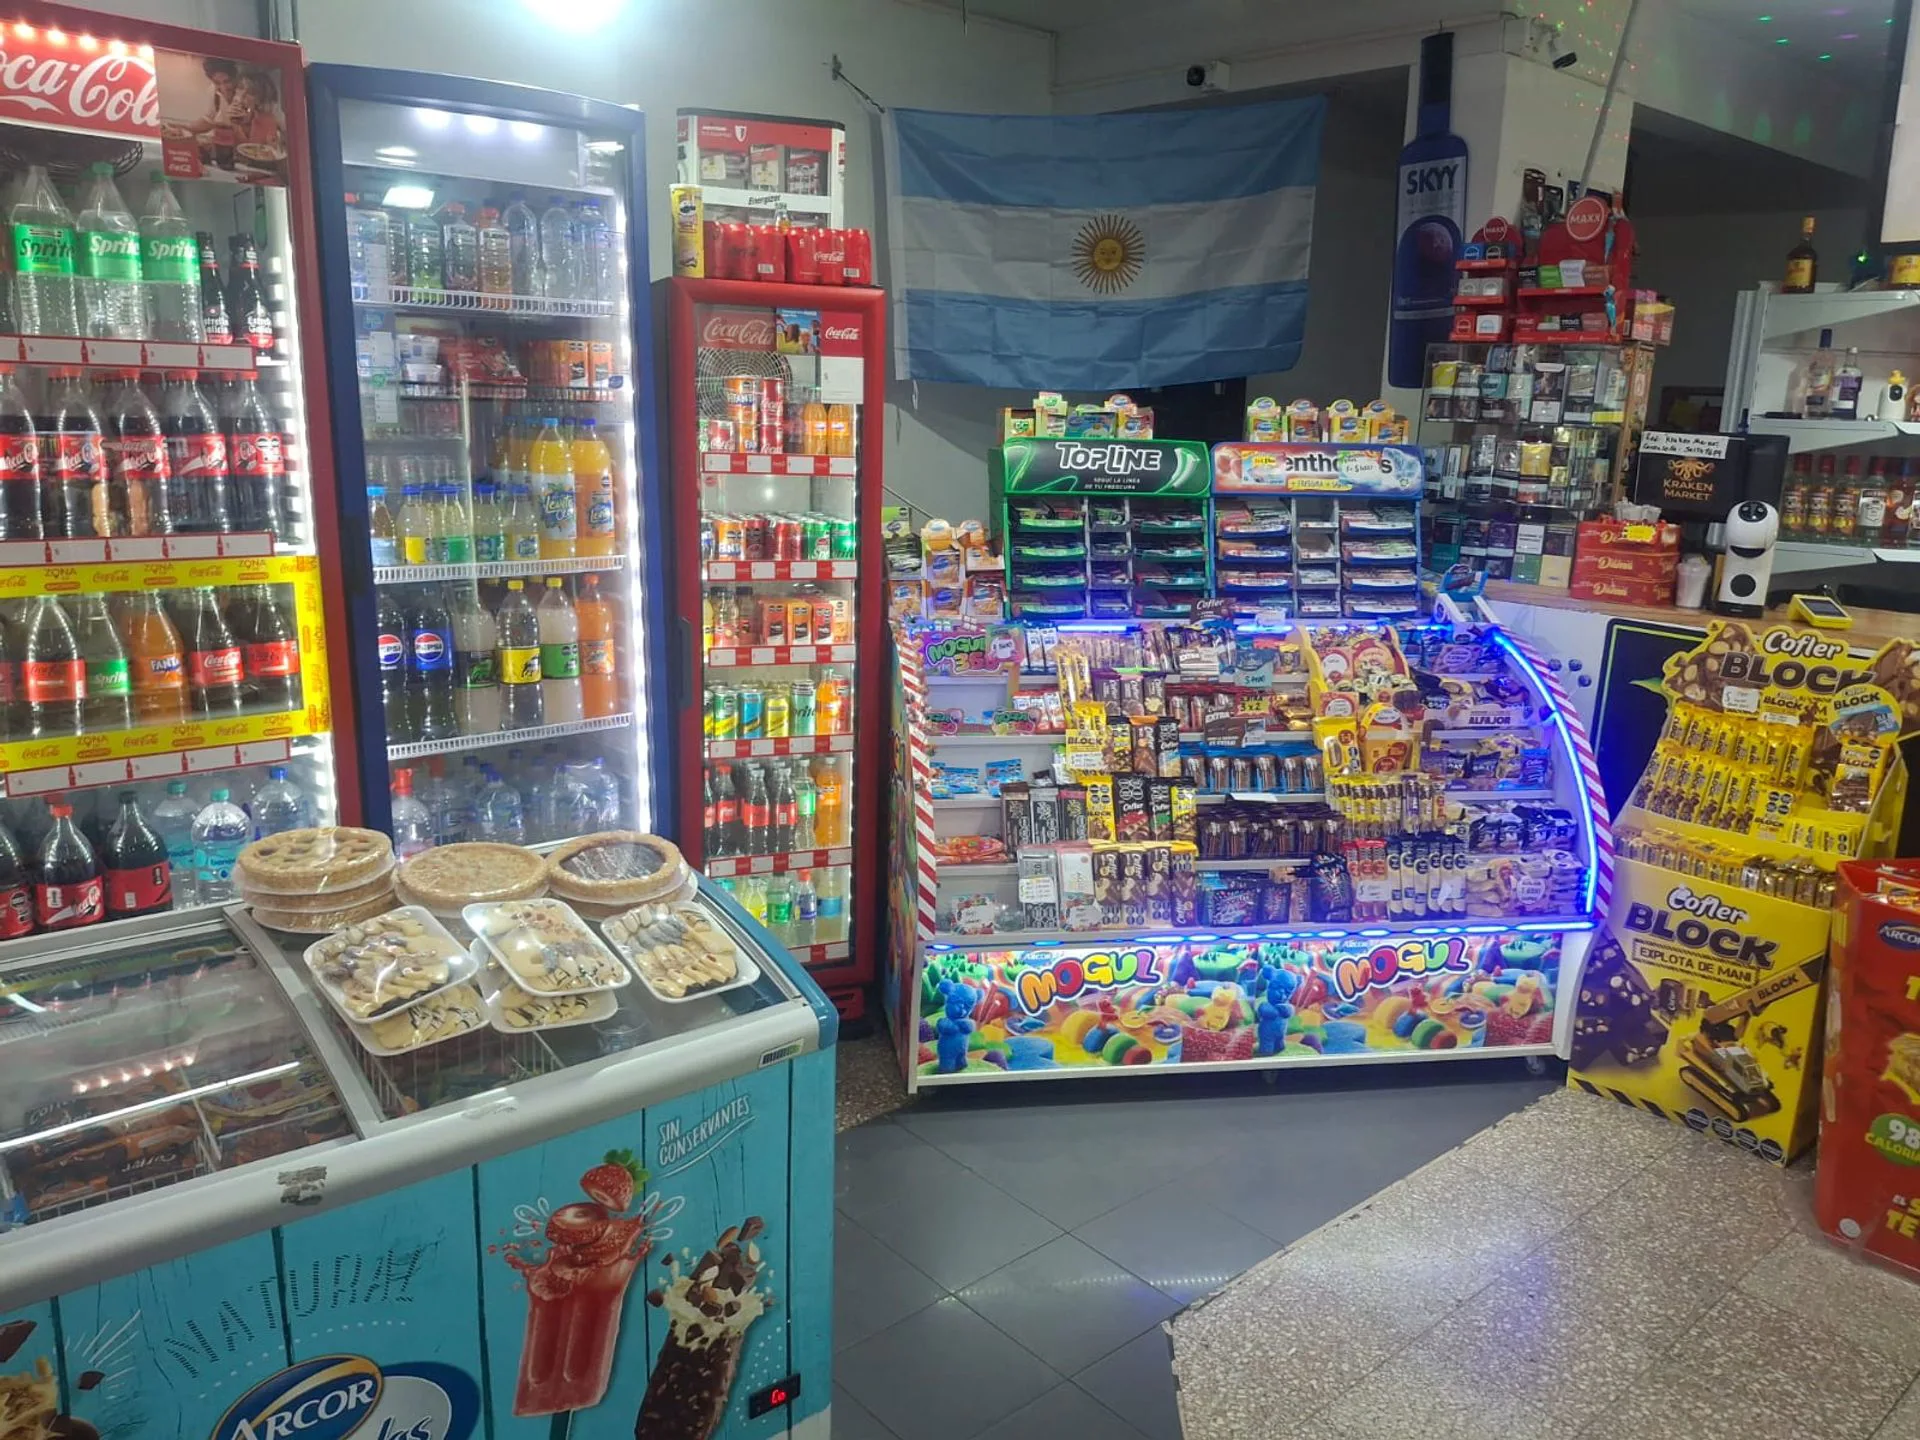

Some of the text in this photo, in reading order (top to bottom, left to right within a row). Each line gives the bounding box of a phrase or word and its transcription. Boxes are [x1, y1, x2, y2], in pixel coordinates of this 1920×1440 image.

[1406, 164, 1459, 195] SKYY
[1569, 213, 1602, 224] MAXX
[703, 317, 776, 346] Coca-Cola
[825, 326, 860, 341] Coca-Cola
[1056, 441, 1162, 474] TOPLINE
[1663, 478, 1713, 493] KRAKEN
[1664, 489, 1712, 501] MARKET
[1196, 600, 1225, 616] Cofler
[1763, 631, 1843, 660] Cofler
[1718, 650, 1877, 695] BLOCK
[1763, 695, 1802, 712] BLOCK
[1833, 690, 1881, 711] BLOCK
[1468, 715, 1511, 725] ALFAJOR
[1068, 736, 1104, 746] BLOCK
[1122, 802, 1144, 813] Cofler
[1666, 884, 1749, 926] Cofler
[1620, 900, 1780, 970] BLOCK
[1335, 936, 1473, 1001] MOGUL
[1640, 945, 1694, 969] EXPLOTA
[1697, 960, 1714, 974] DE
[1016, 947, 1165, 1017] MOGUL
[1756, 972, 1800, 1000] BLOCK
[658, 1095, 752, 1167] CONSERVANTES
[660, 1118, 682, 1146] SIN
[1889, 1118, 1920, 1150] 98
[229, 1378, 376, 1440] ARCOR
